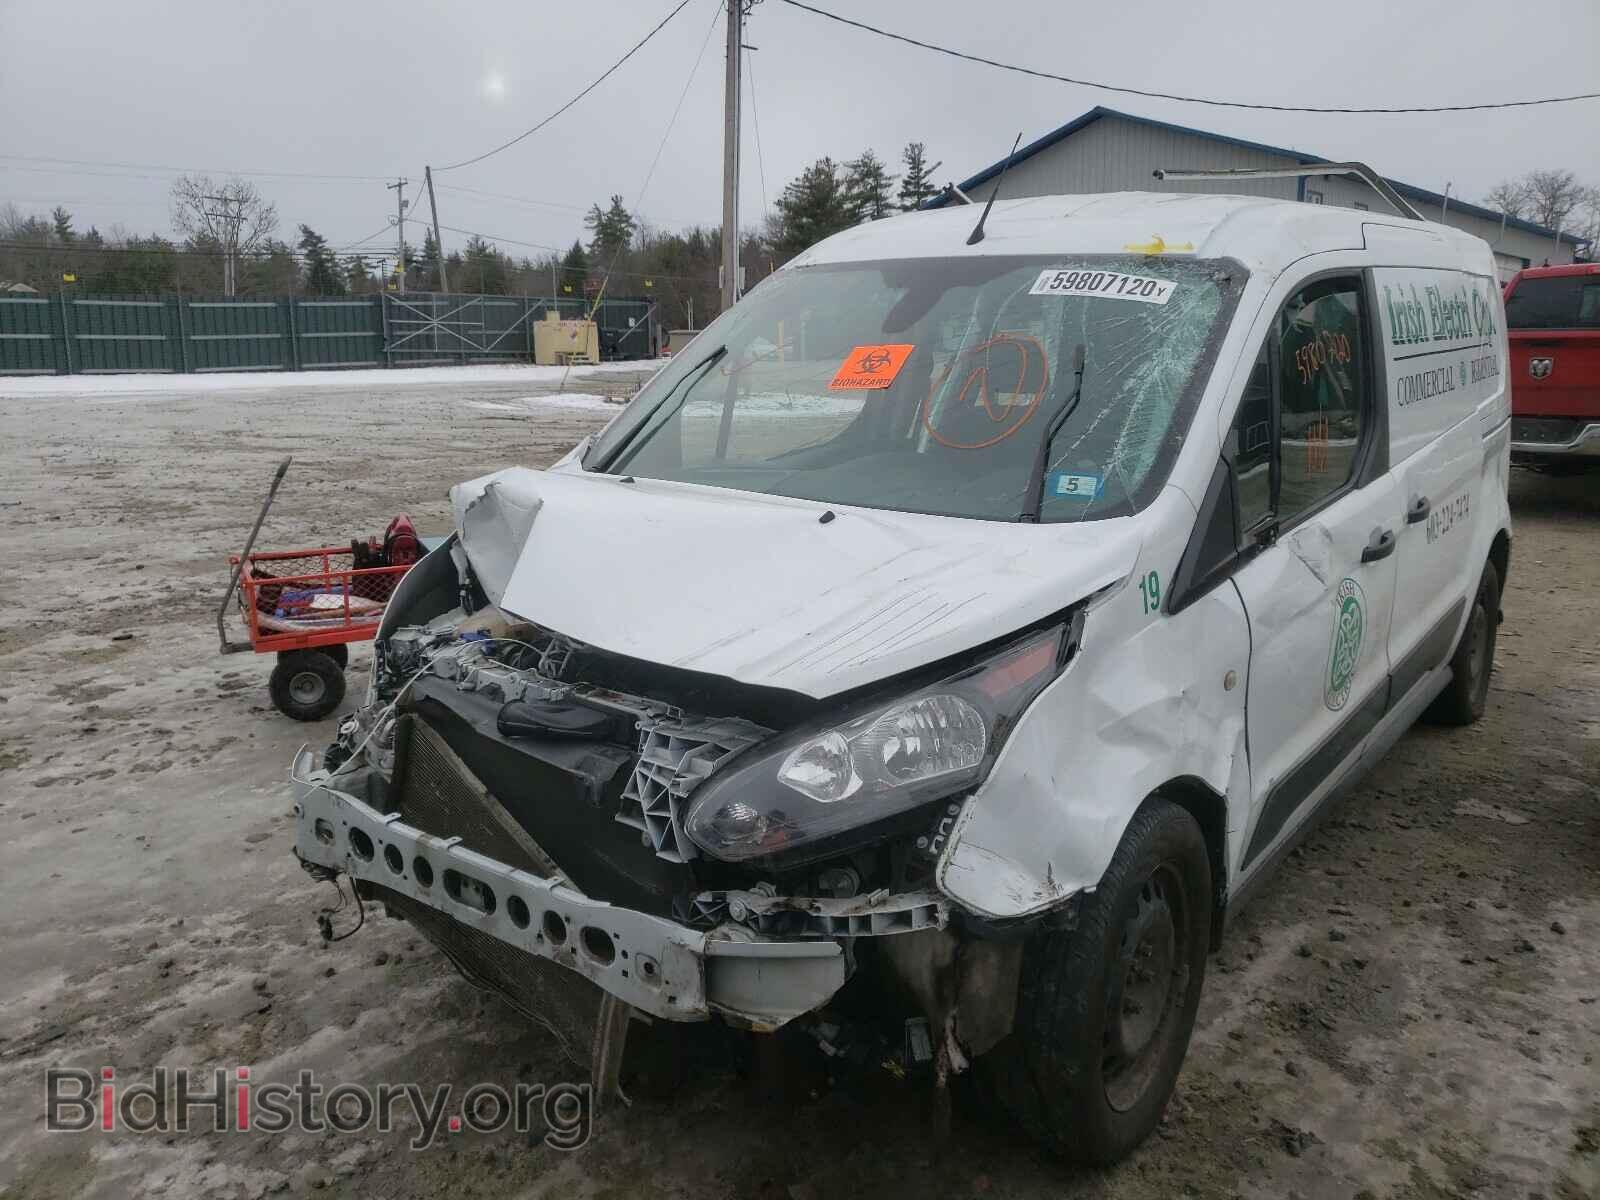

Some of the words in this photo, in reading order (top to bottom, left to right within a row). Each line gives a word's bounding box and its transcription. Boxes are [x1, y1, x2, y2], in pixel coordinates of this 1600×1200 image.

[1397, 366, 1456, 407] COMMERCIAL
[1065, 477, 1080, 493] 5
[1139, 570, 1160, 615] 19
